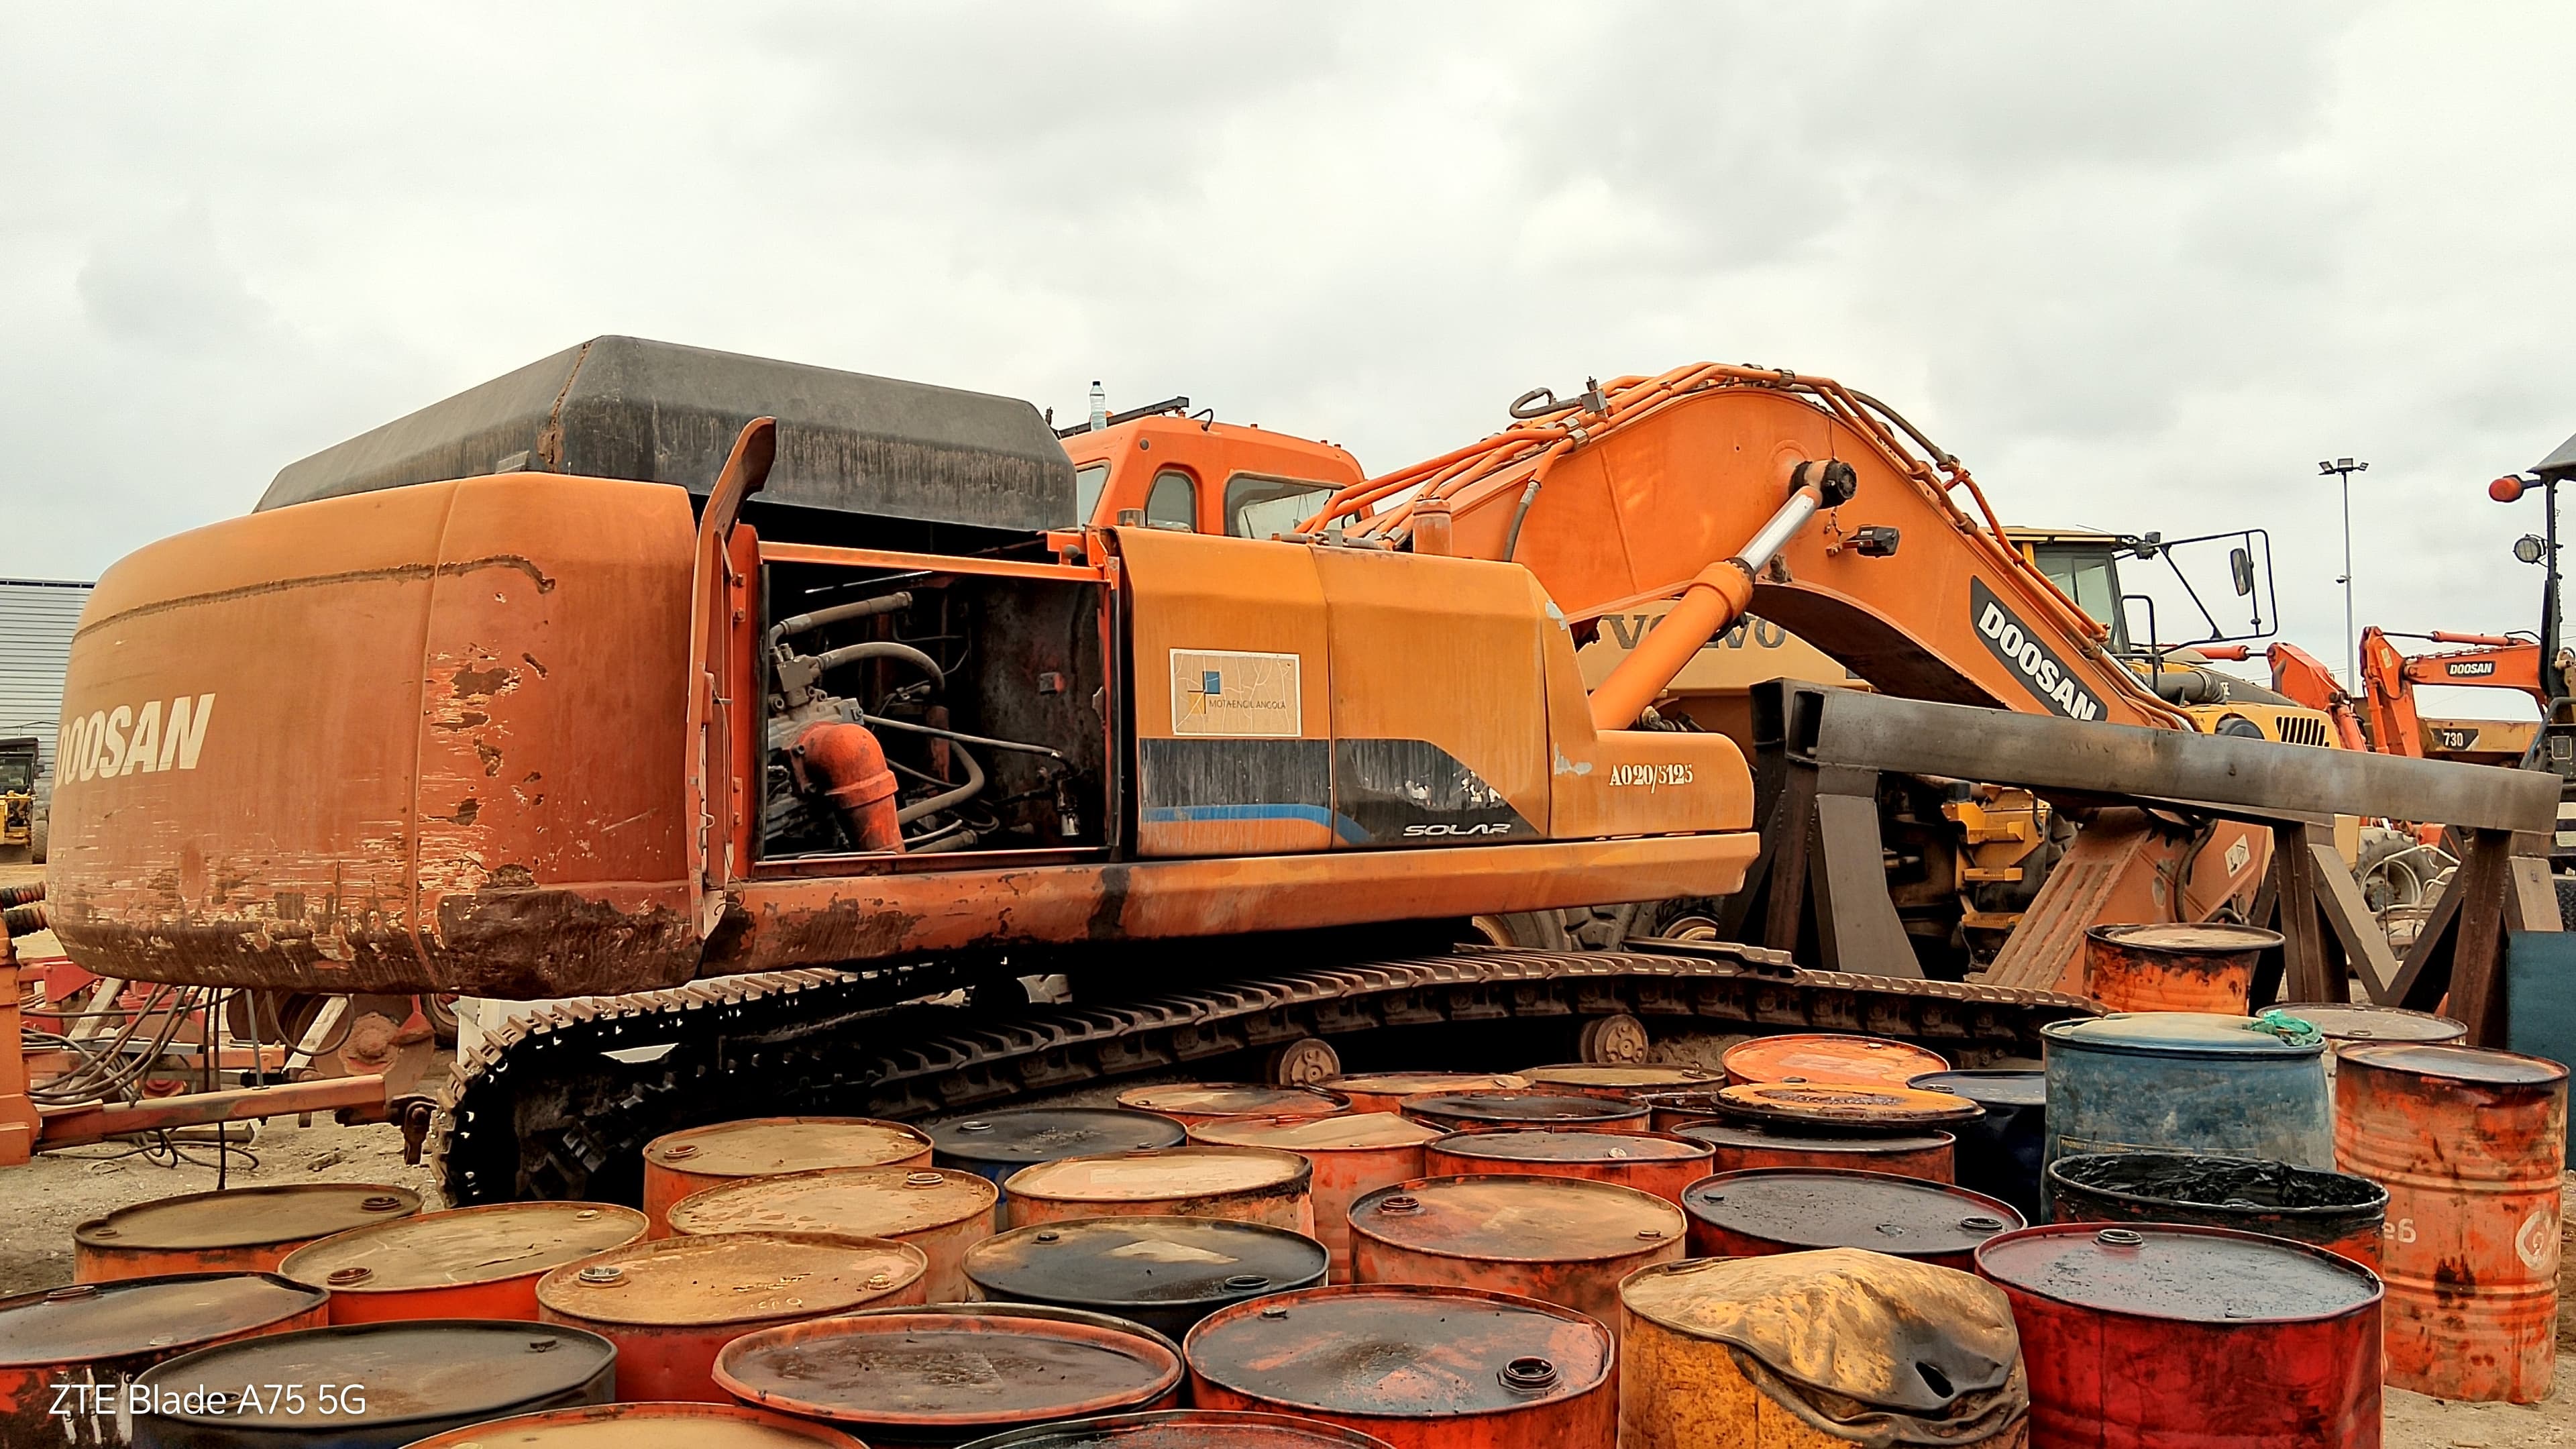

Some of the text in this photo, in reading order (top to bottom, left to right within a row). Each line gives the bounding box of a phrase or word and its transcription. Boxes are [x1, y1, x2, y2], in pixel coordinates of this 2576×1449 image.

[1603, 614, 1786, 649] VVO
[1978, 602, 2098, 721] DOOSAN
[2449, 662, 2493, 675] DOOSAN
[1209, 699, 1254, 709] MOTAENGL
[54, 693, 216, 790] DOOSAN
[2443, 732, 2464, 747] 730
[1609, 763, 1693, 794] A020/5125
[1403, 823, 1511, 837] SOLAR
